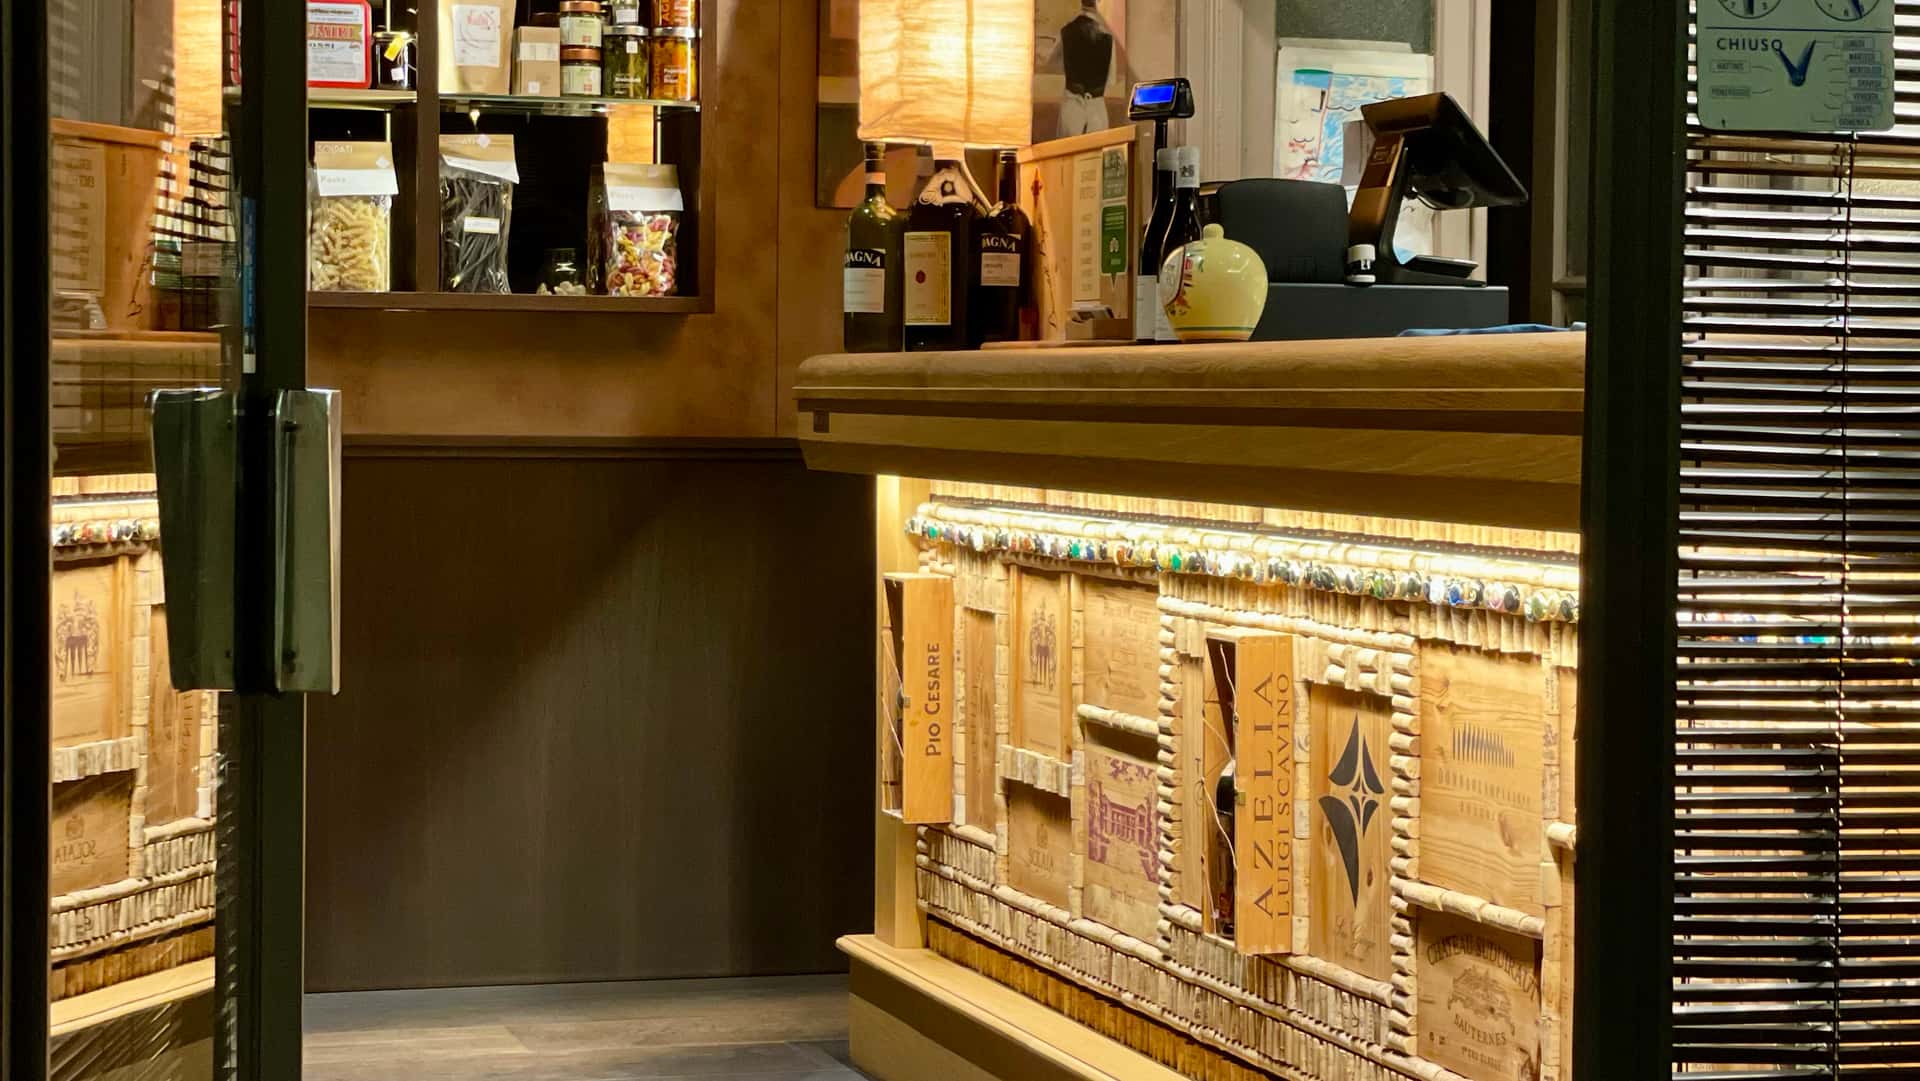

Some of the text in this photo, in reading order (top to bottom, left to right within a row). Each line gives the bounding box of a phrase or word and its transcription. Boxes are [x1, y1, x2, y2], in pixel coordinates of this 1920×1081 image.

[1716, 36, 1783, 52] CHIUSO
[924, 642, 942, 758] PIO CESARE
[1252, 672, 1274, 918] AZELIA
[1276, 673, 1291, 918] LUIGI SCAVINO
